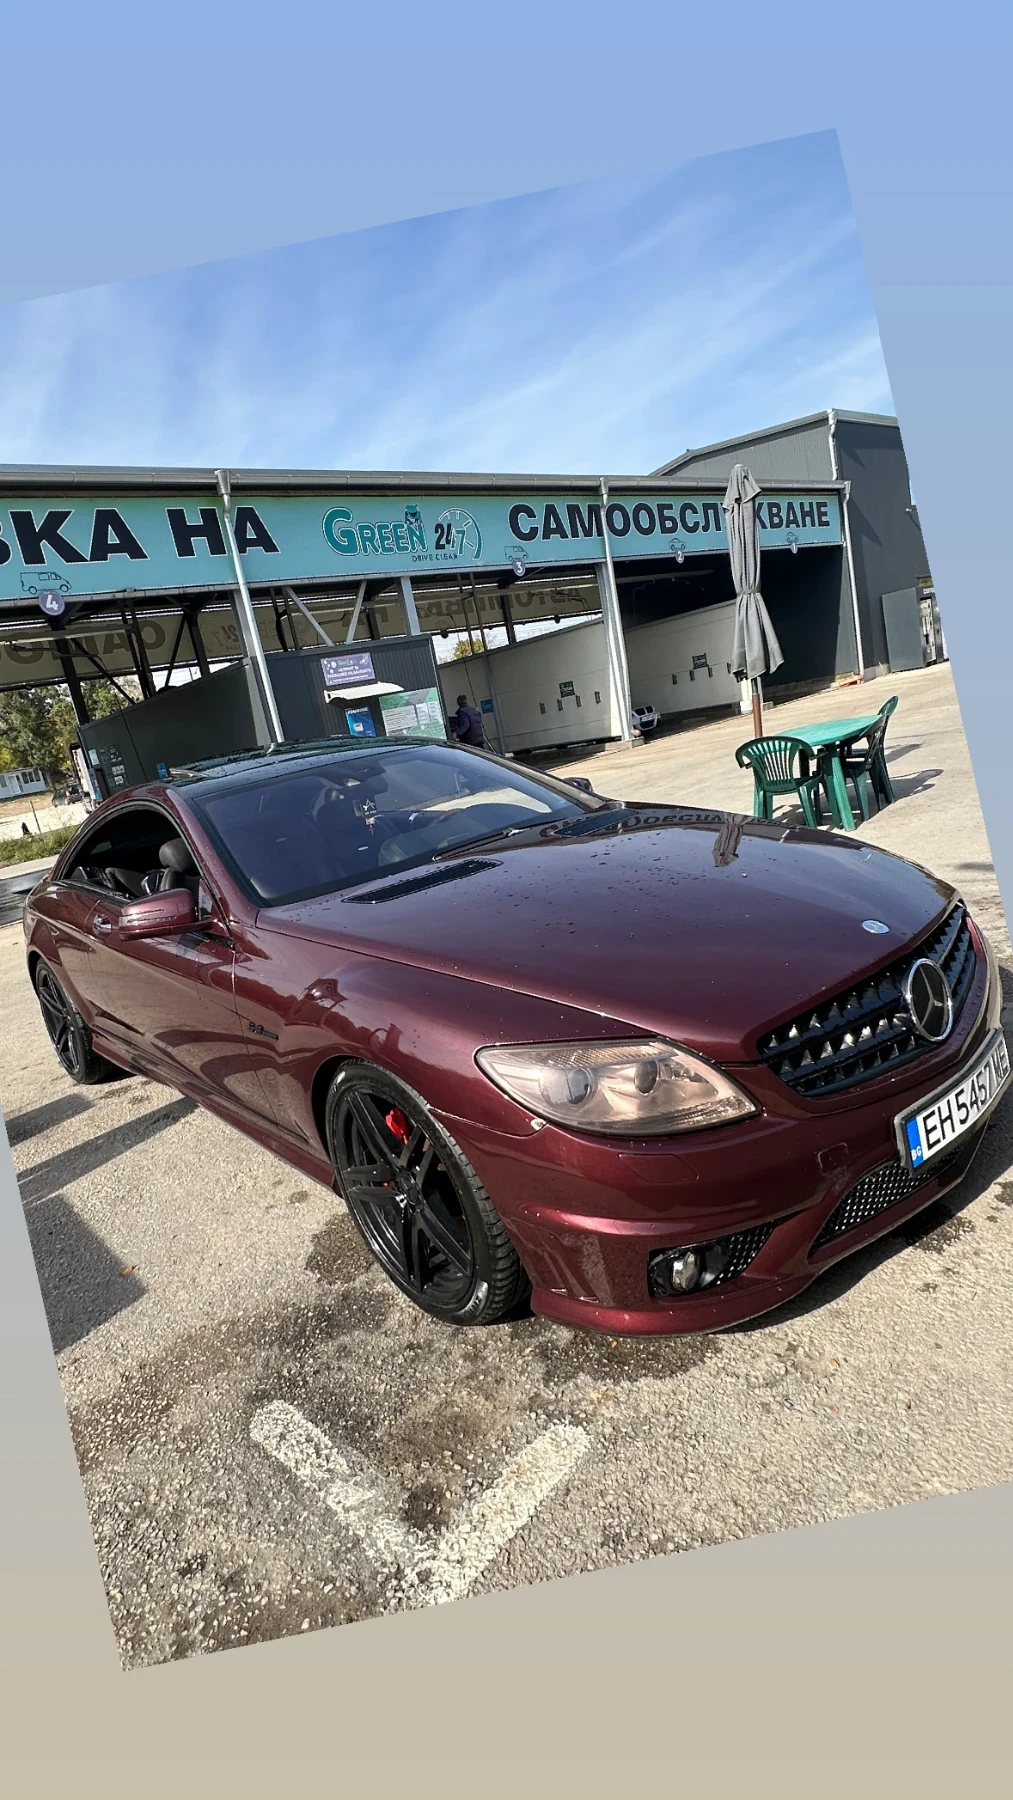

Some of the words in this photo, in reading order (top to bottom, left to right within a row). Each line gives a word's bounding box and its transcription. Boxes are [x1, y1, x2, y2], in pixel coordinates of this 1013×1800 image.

[508, 501, 831, 542] САМООБСЛВАНЕ
[0, 508, 150, 566] КА
[165, 506, 281, 558] НА
[411, 553, 434, 563] DRIVE
[515, 561, 523, 573] 3
[46, 594, 59, 610] 4
[911, 1145, 922, 1160] BG
